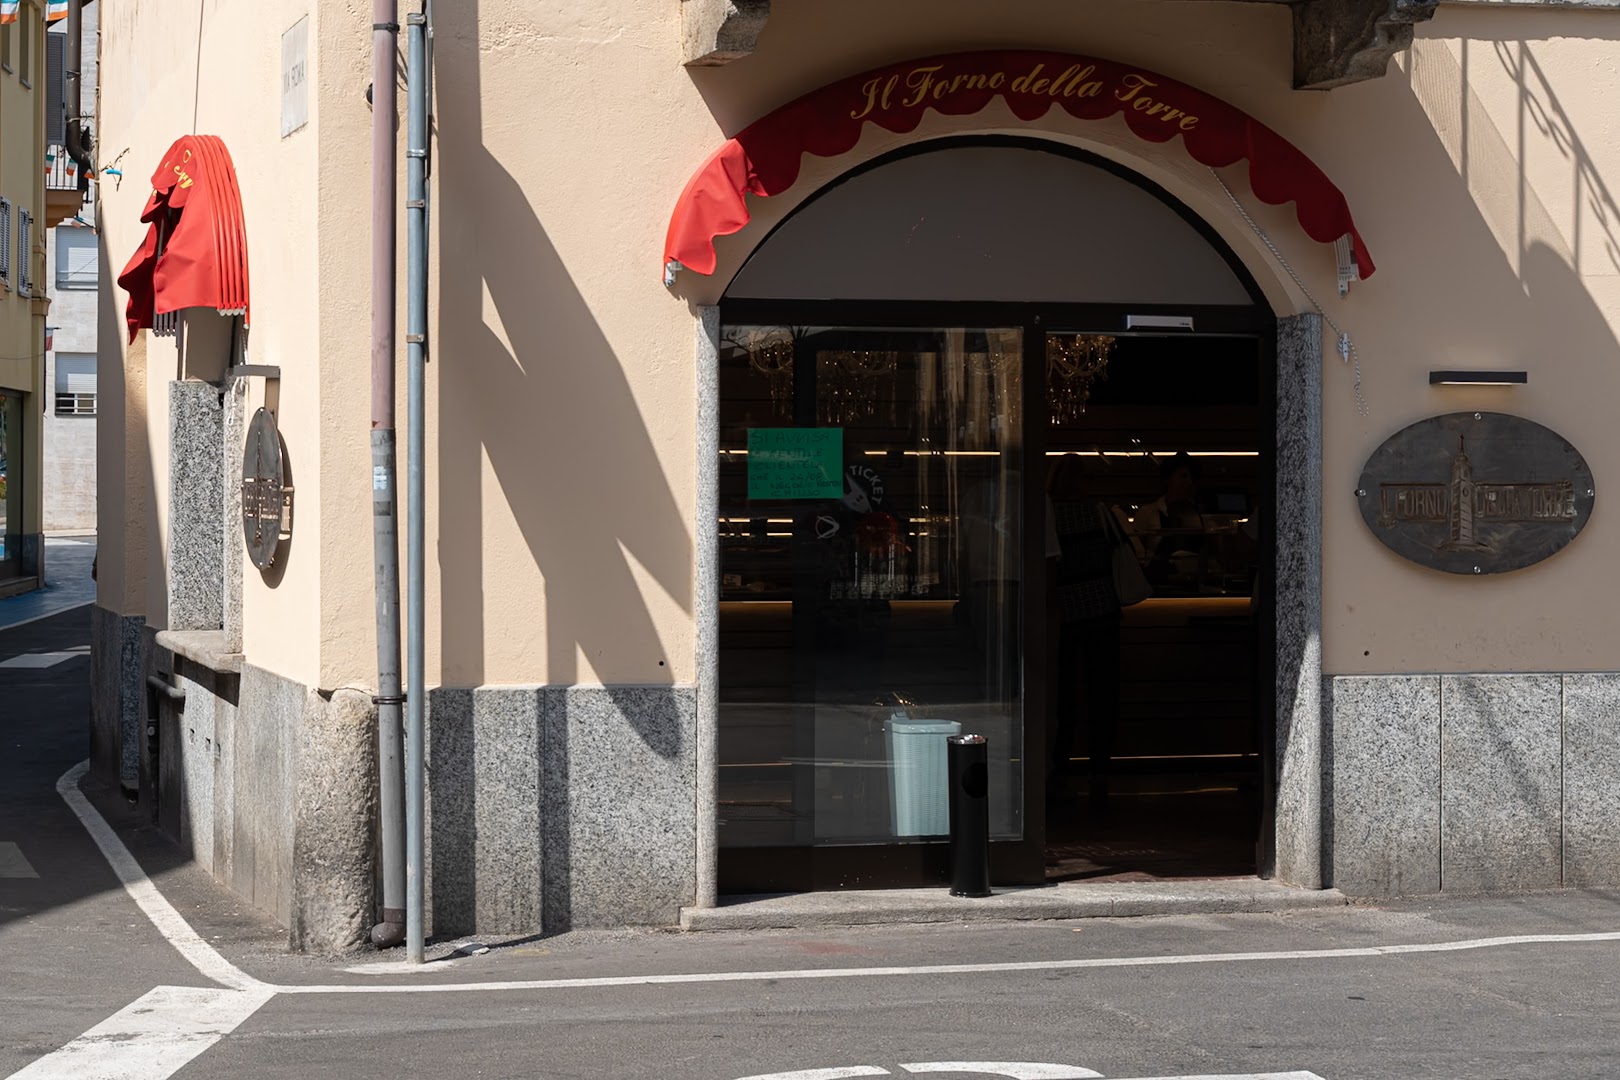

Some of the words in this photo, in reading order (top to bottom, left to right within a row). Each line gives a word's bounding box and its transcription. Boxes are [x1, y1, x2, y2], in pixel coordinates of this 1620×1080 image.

[850, 74, 899, 120] Il
[902, 64, 1006, 108] Forno
[1010, 63, 1104, 98] della
[1114, 73, 1200, 130] Torre
[751, 431, 768, 445] SI
[849, 464, 884, 505] TICKET
[1395, 487, 1448, 517] FORNO
